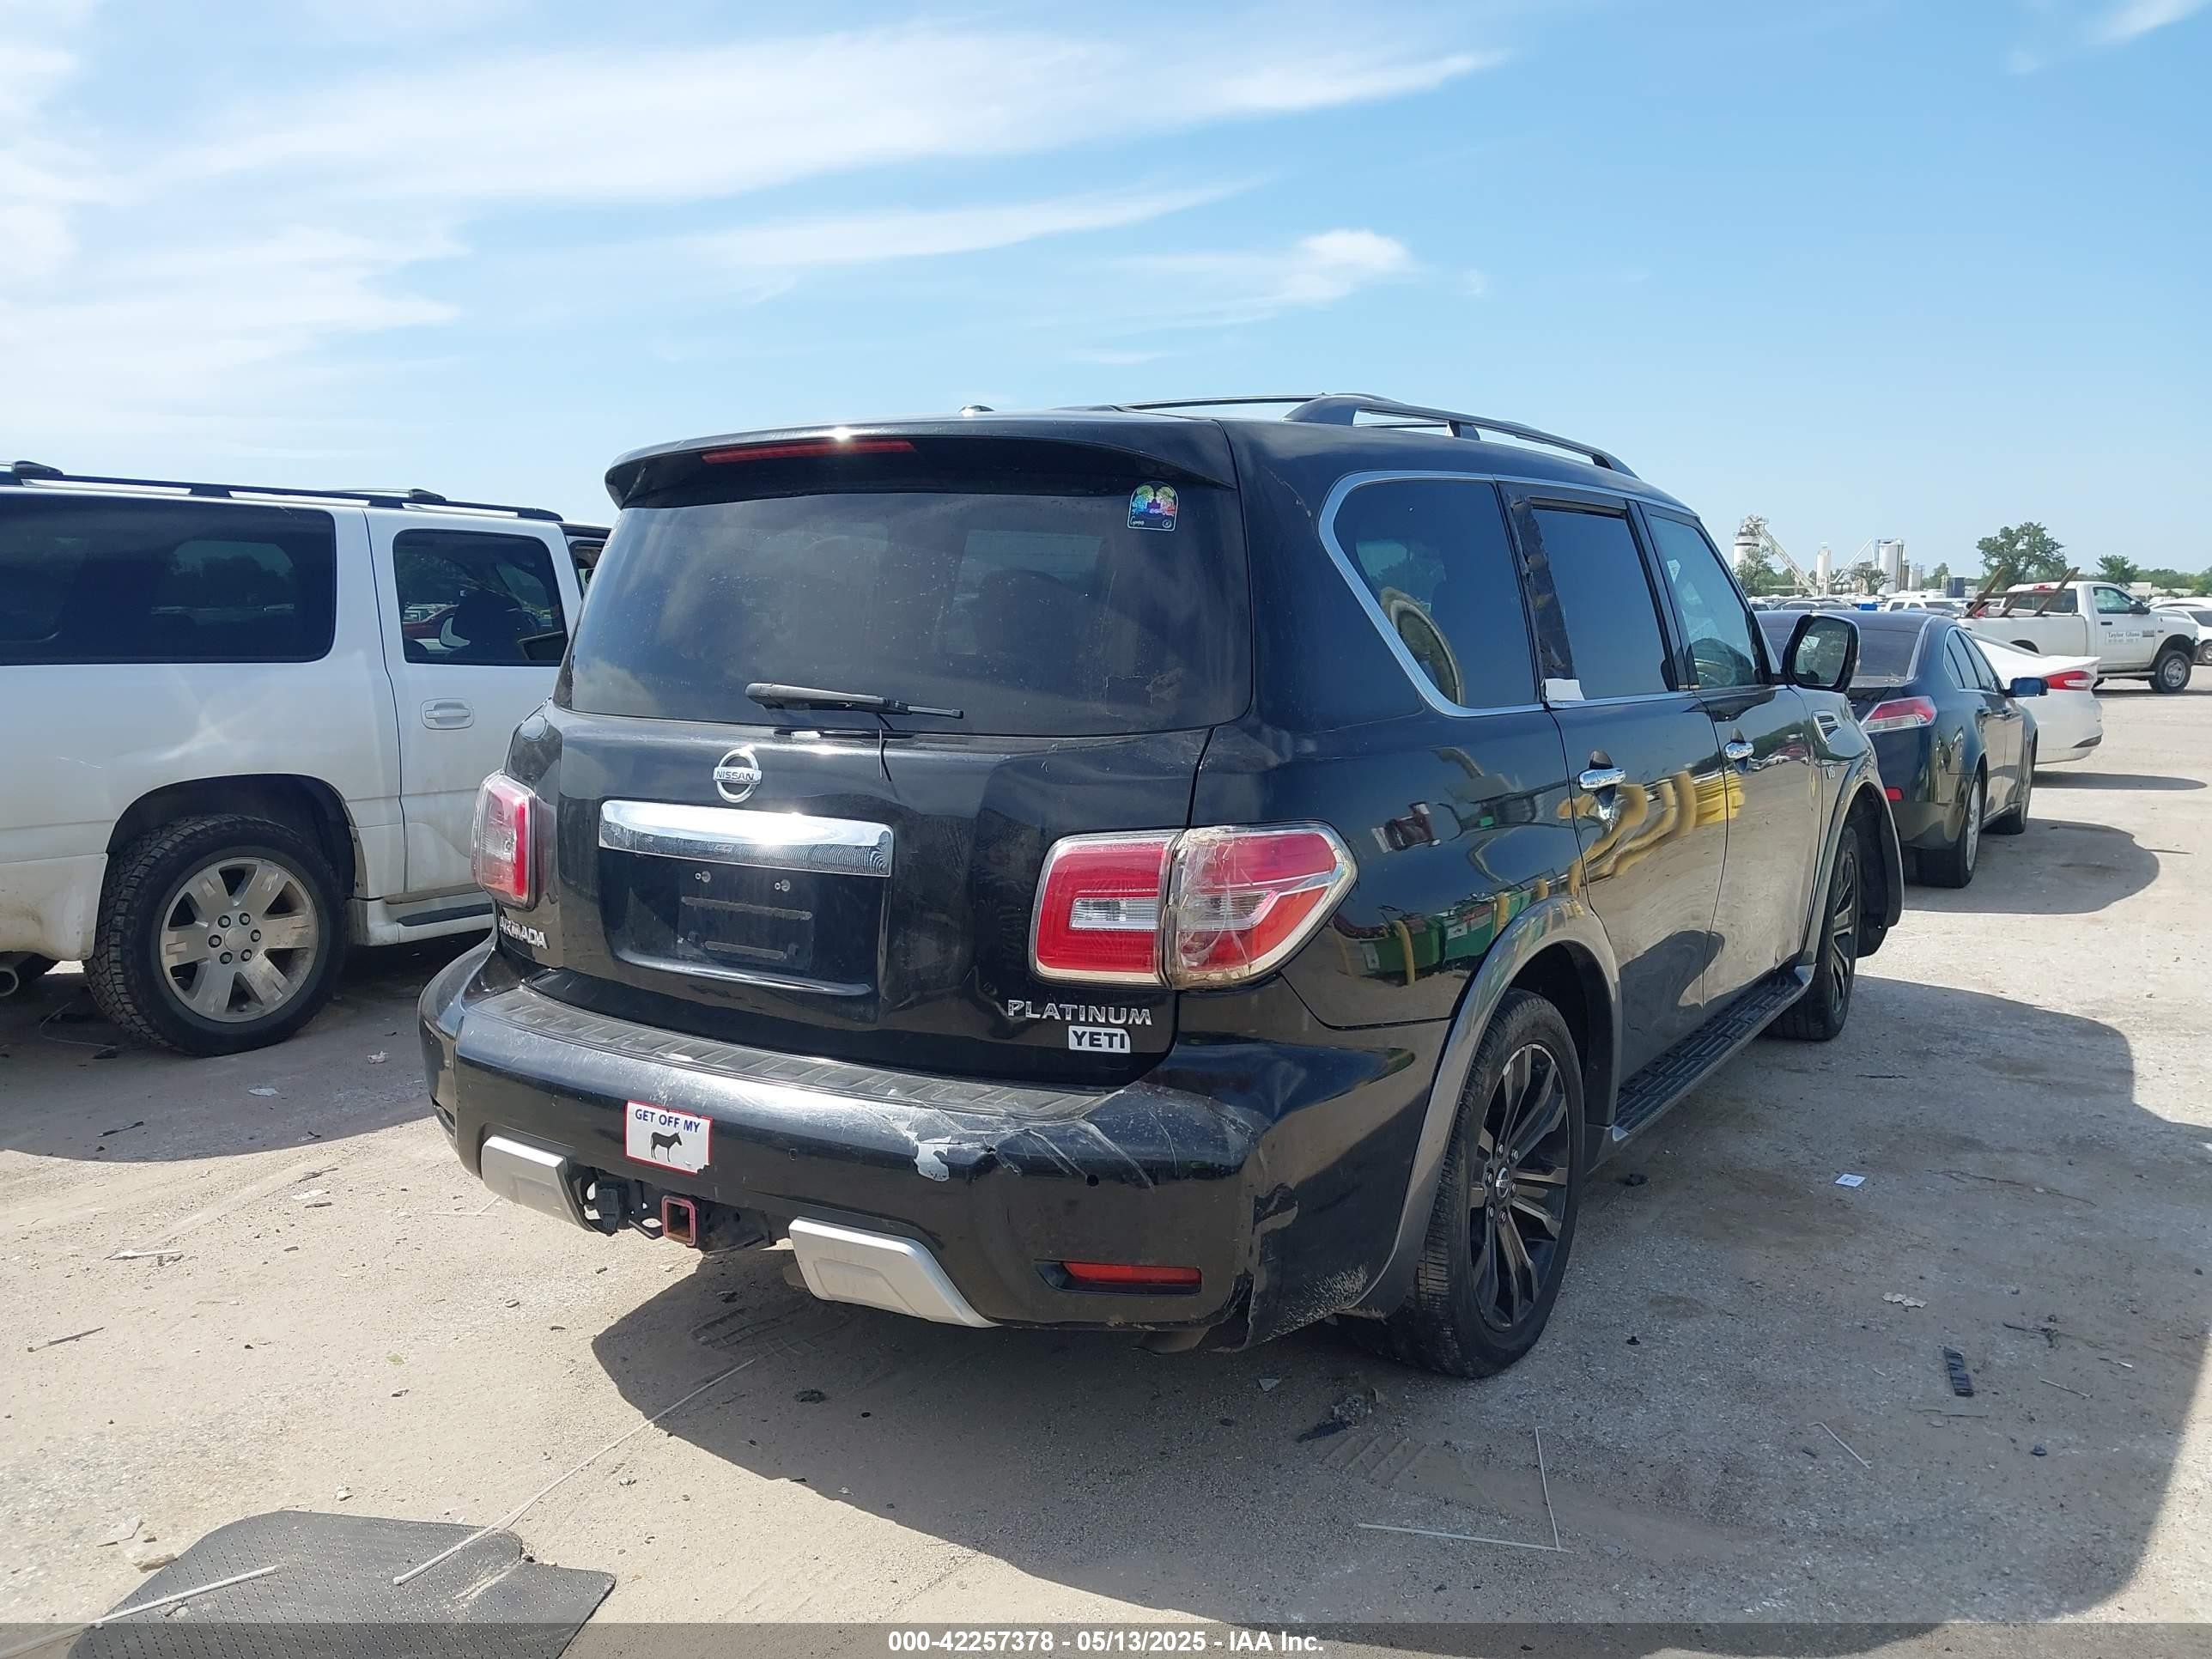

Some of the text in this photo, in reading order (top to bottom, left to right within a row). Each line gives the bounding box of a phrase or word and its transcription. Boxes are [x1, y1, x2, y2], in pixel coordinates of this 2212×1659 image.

[716, 770, 755, 781] NISSAN
[499, 915, 549, 950] ARMADA
[1007, 999, 1152, 1026] PLATINUM
[1071, 1030, 1127, 1049] YETI
[635, 1109, 702, 1133] GET OFF MY
